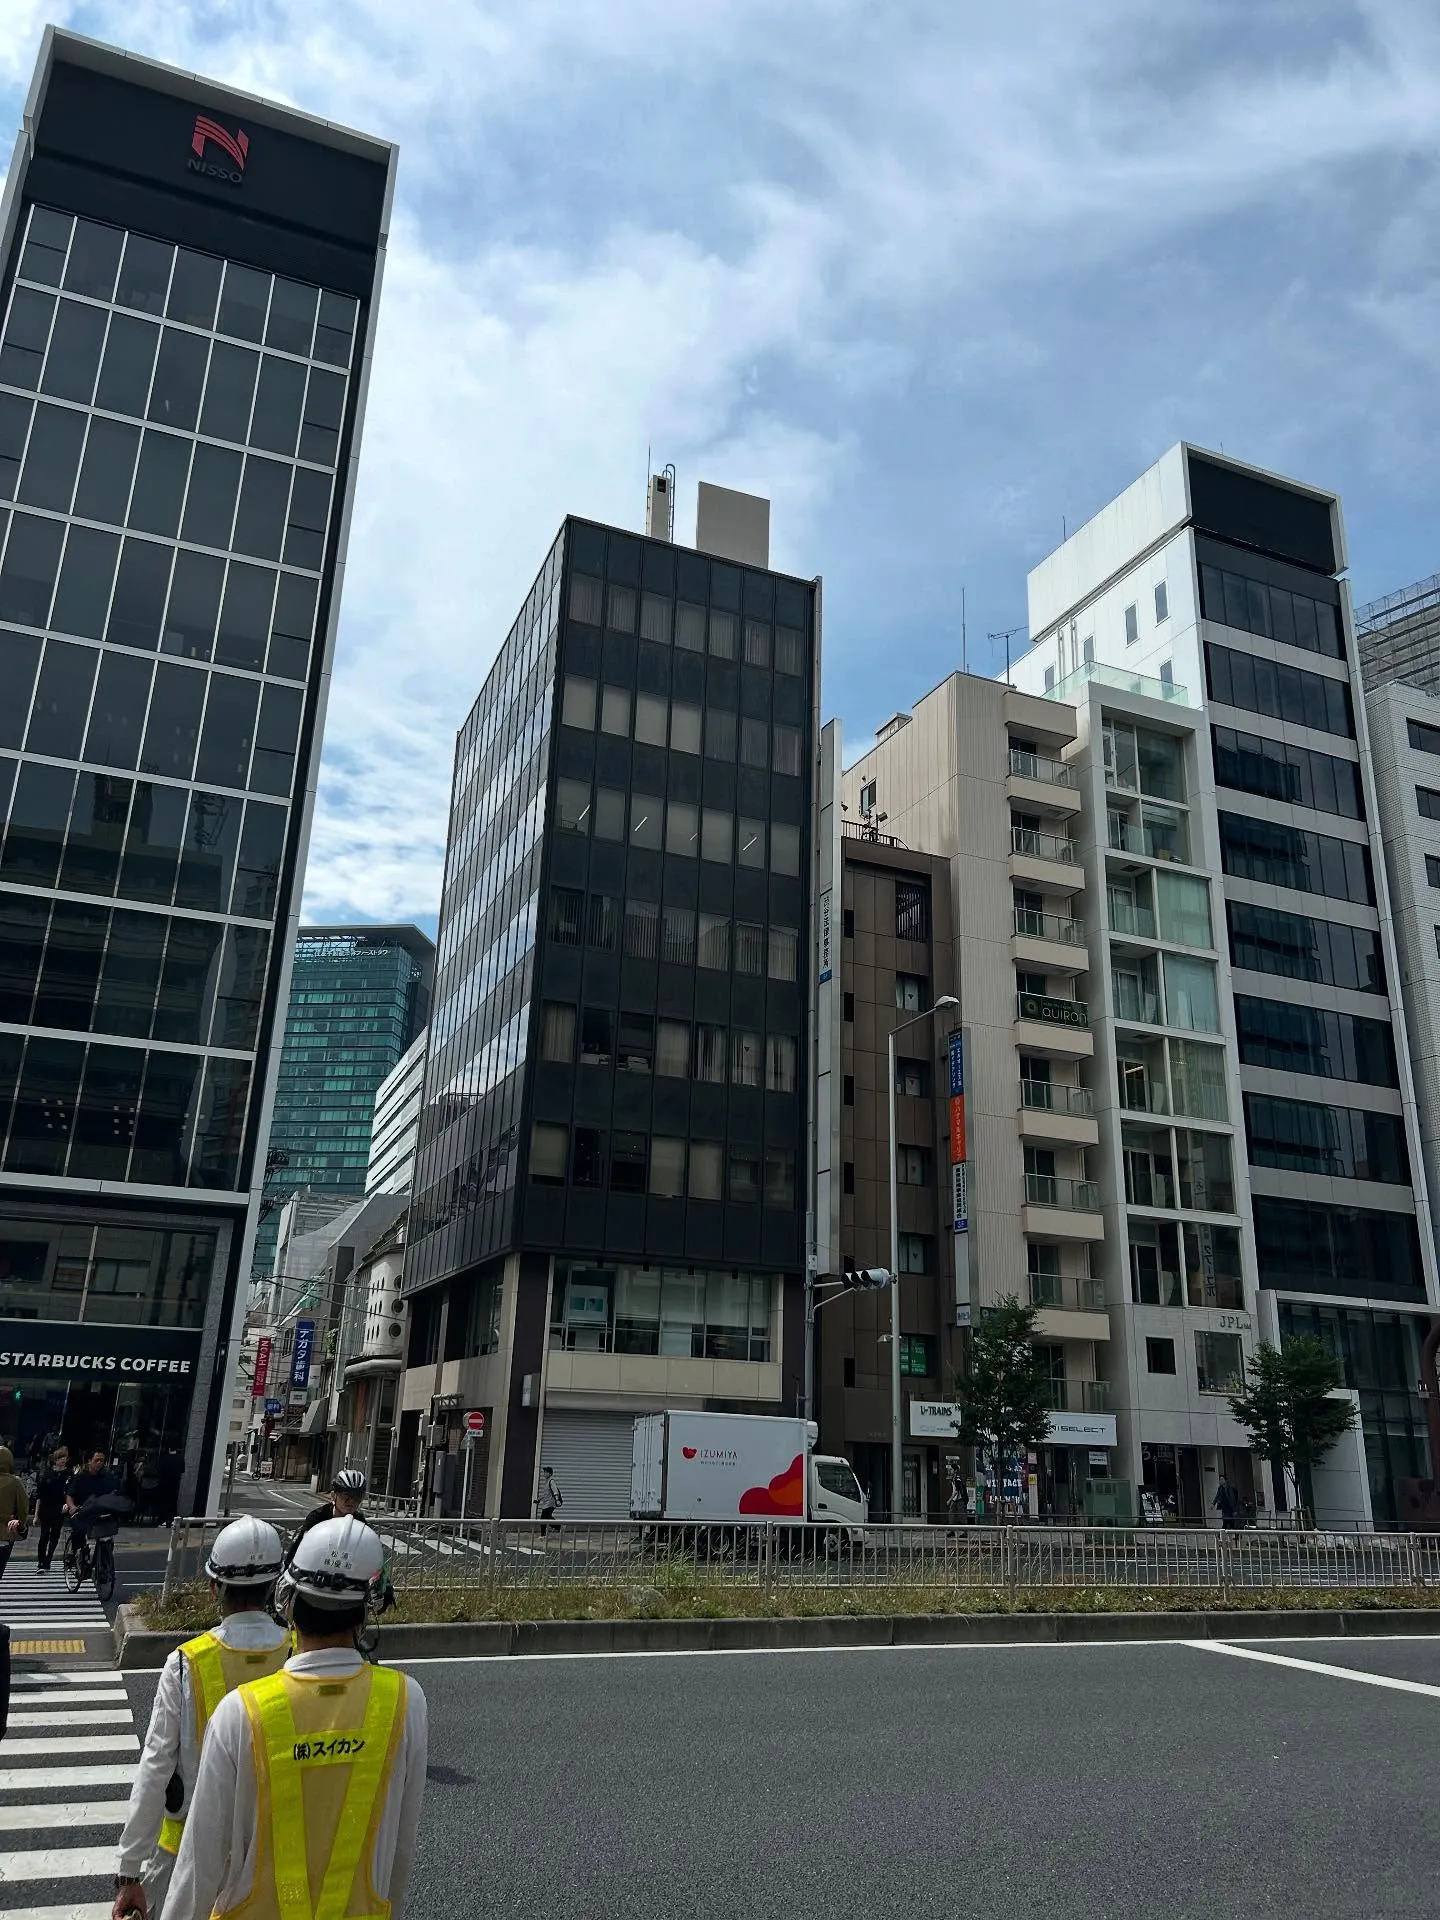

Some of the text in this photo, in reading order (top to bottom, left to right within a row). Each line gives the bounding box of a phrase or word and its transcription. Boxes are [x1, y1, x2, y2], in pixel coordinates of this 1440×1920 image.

[187, 158, 243, 183] NISSO
[1220, 1315, 1243, 1329] JPL
[0, 1352, 191, 1373] STARBUCKS COFFEE
[258, 1340, 269, 1366] NOAH
[700, 1449, 738, 1460] IZUMIYA
[293, 1738, 366, 1760] (株)スイカン
